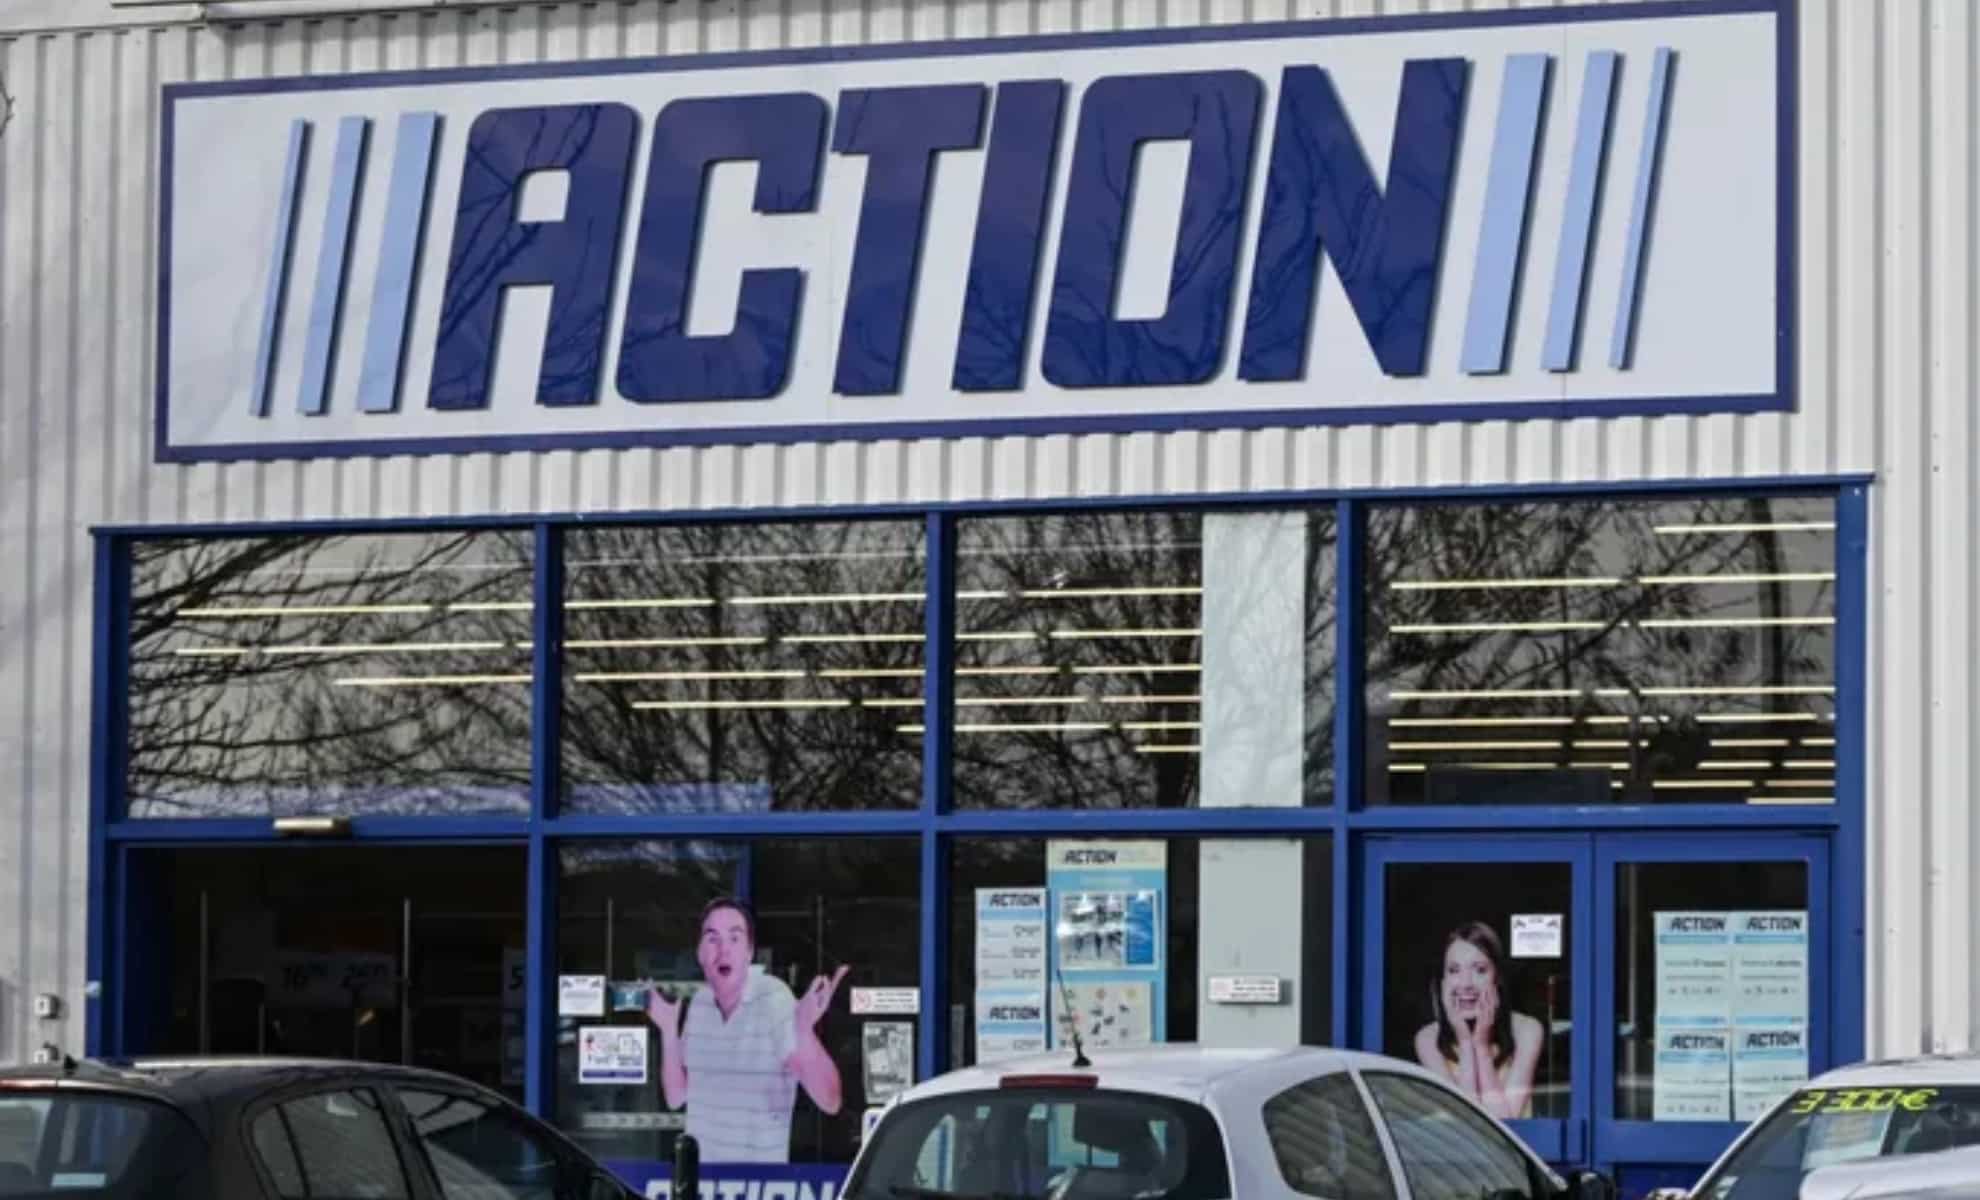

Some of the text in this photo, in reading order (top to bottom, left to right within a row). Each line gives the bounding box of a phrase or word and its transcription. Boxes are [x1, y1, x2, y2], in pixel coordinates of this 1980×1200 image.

[427, 55, 1474, 409] ACTION
[1063, 849, 1117, 864] ACTION
[989, 893, 1041, 907] ACTION
[1671, 917, 1727, 931] ACTION
[1746, 917, 1802, 931] ACTION
[989, 1006, 1041, 1020] ACTION
[1670, 1034, 1725, 1049] ACTION
[1746, 1031, 1801, 1047] ACTION
